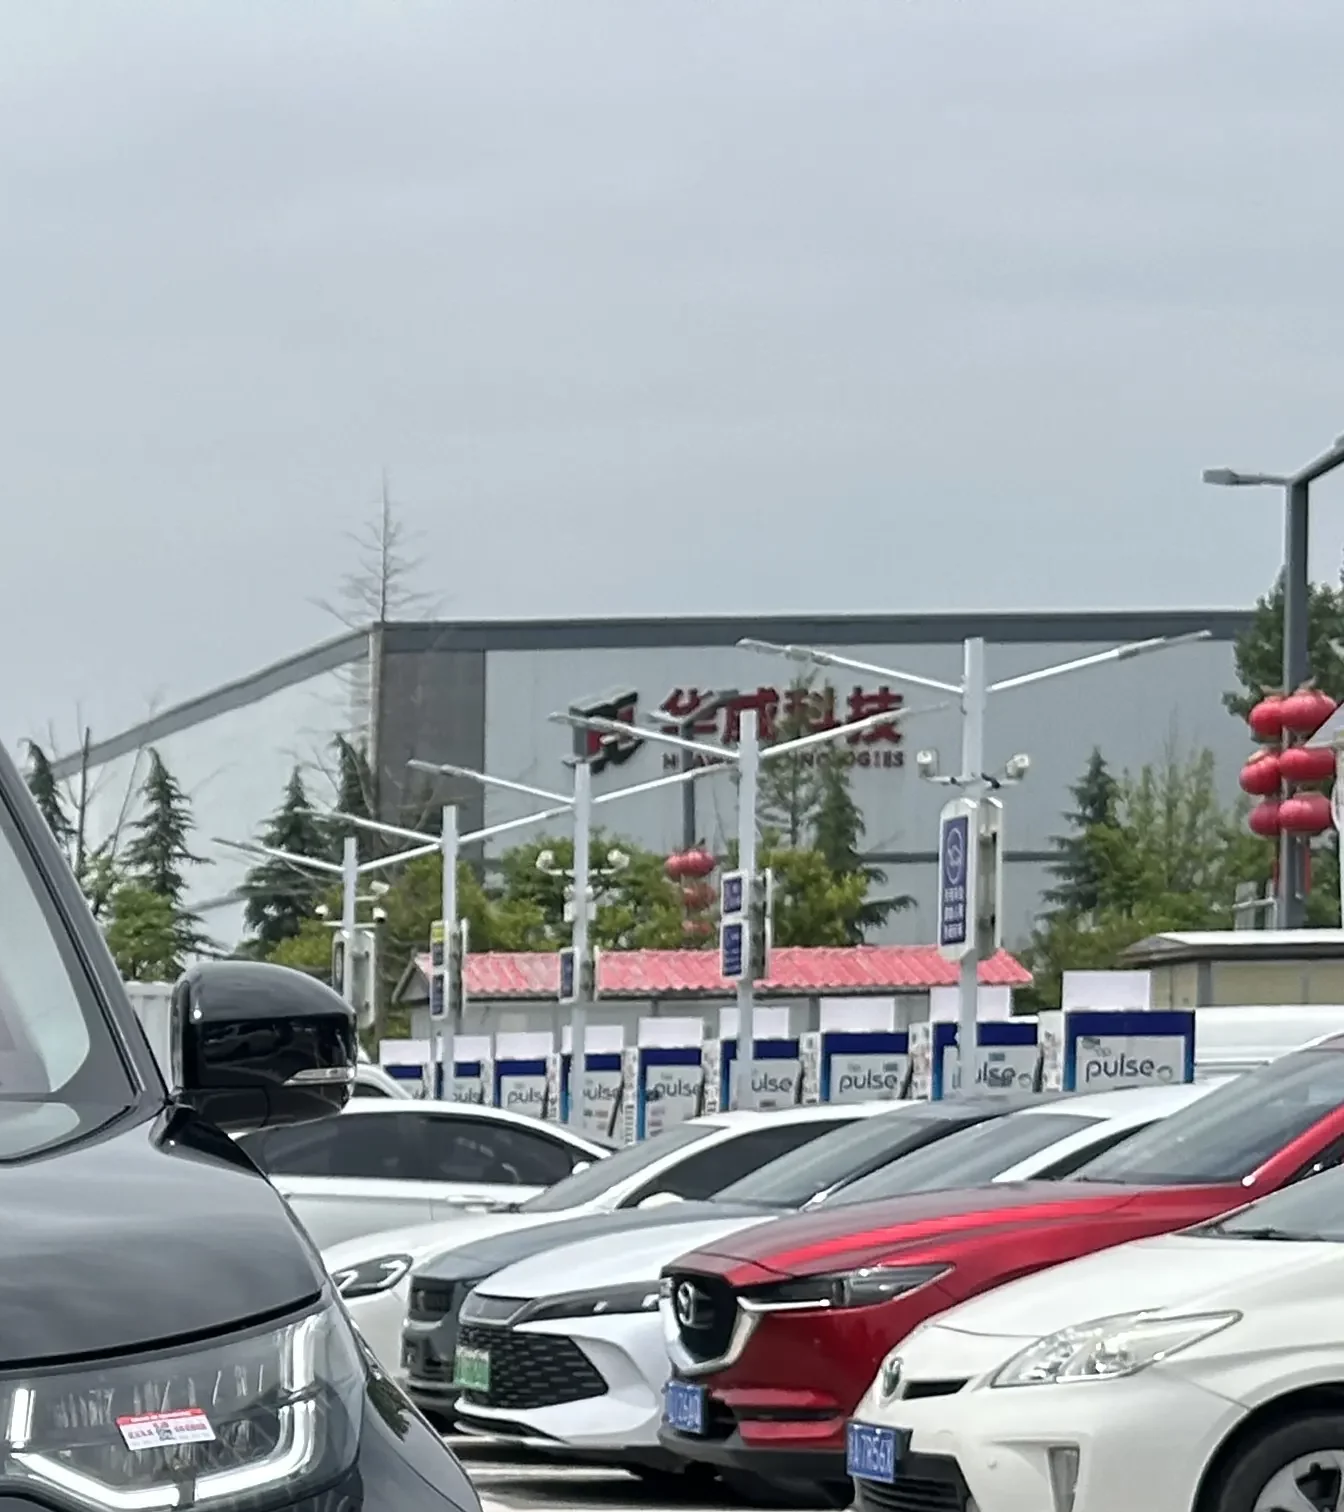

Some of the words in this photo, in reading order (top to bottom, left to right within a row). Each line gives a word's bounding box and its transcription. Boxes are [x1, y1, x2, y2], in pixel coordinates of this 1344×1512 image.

[1086, 1053, 1154, 1082] pulse
[752, 1073, 793, 1092] ulse
[839, 1072, 898, 1093] pulse
